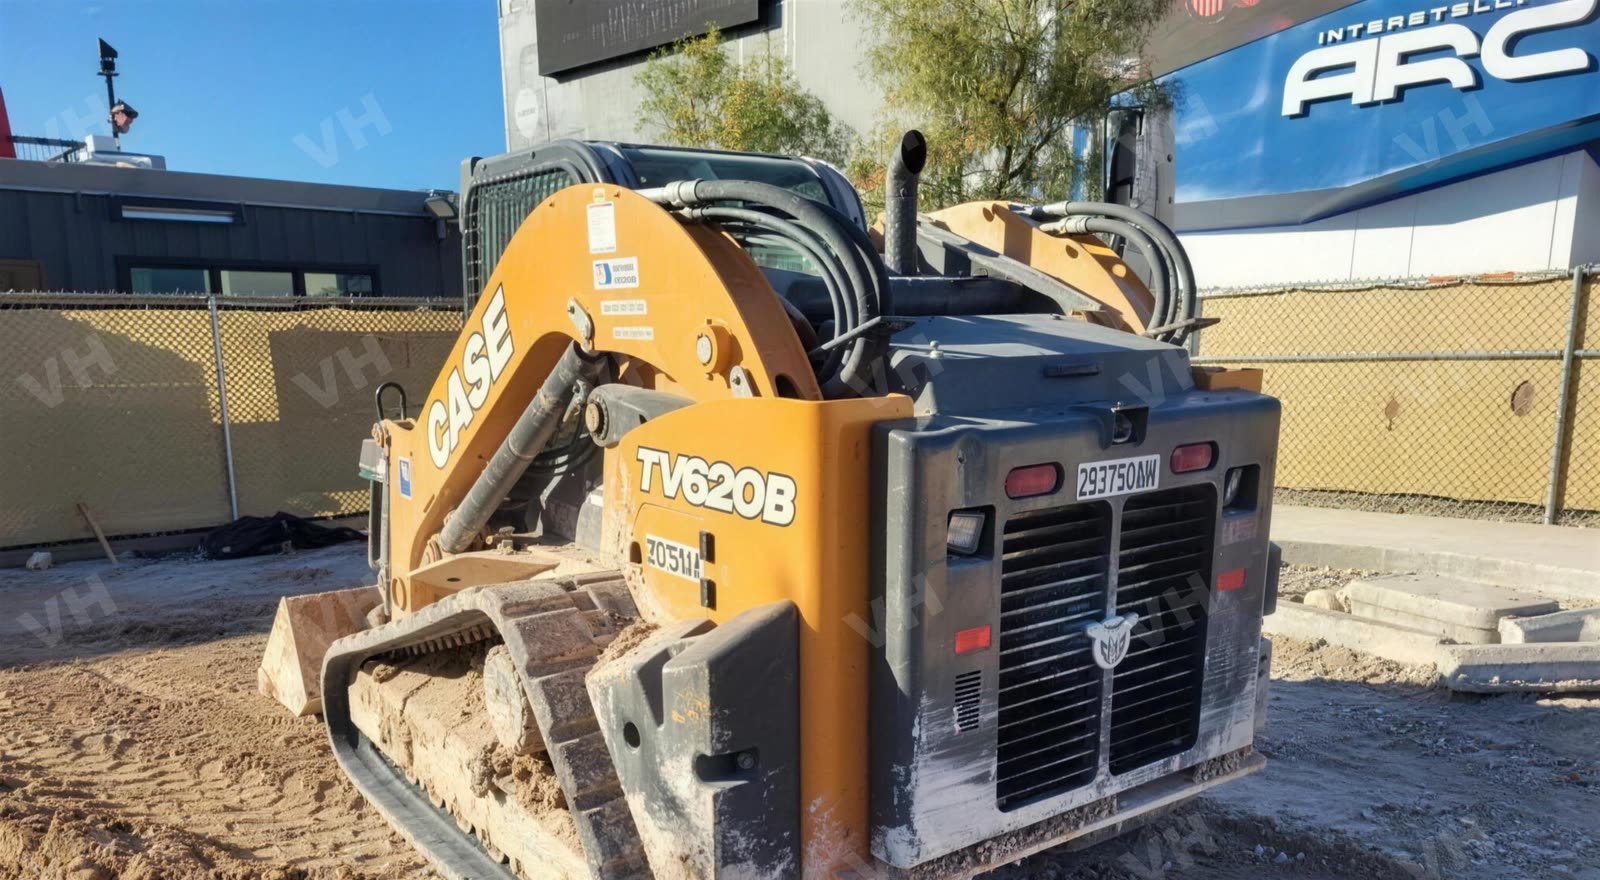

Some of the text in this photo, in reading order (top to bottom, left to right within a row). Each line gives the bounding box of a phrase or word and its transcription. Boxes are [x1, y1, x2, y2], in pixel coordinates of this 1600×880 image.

[1281, 0, 1597, 117] ARC
[427, 282, 515, 469] CASE
[636, 445, 798, 528] TV620B
